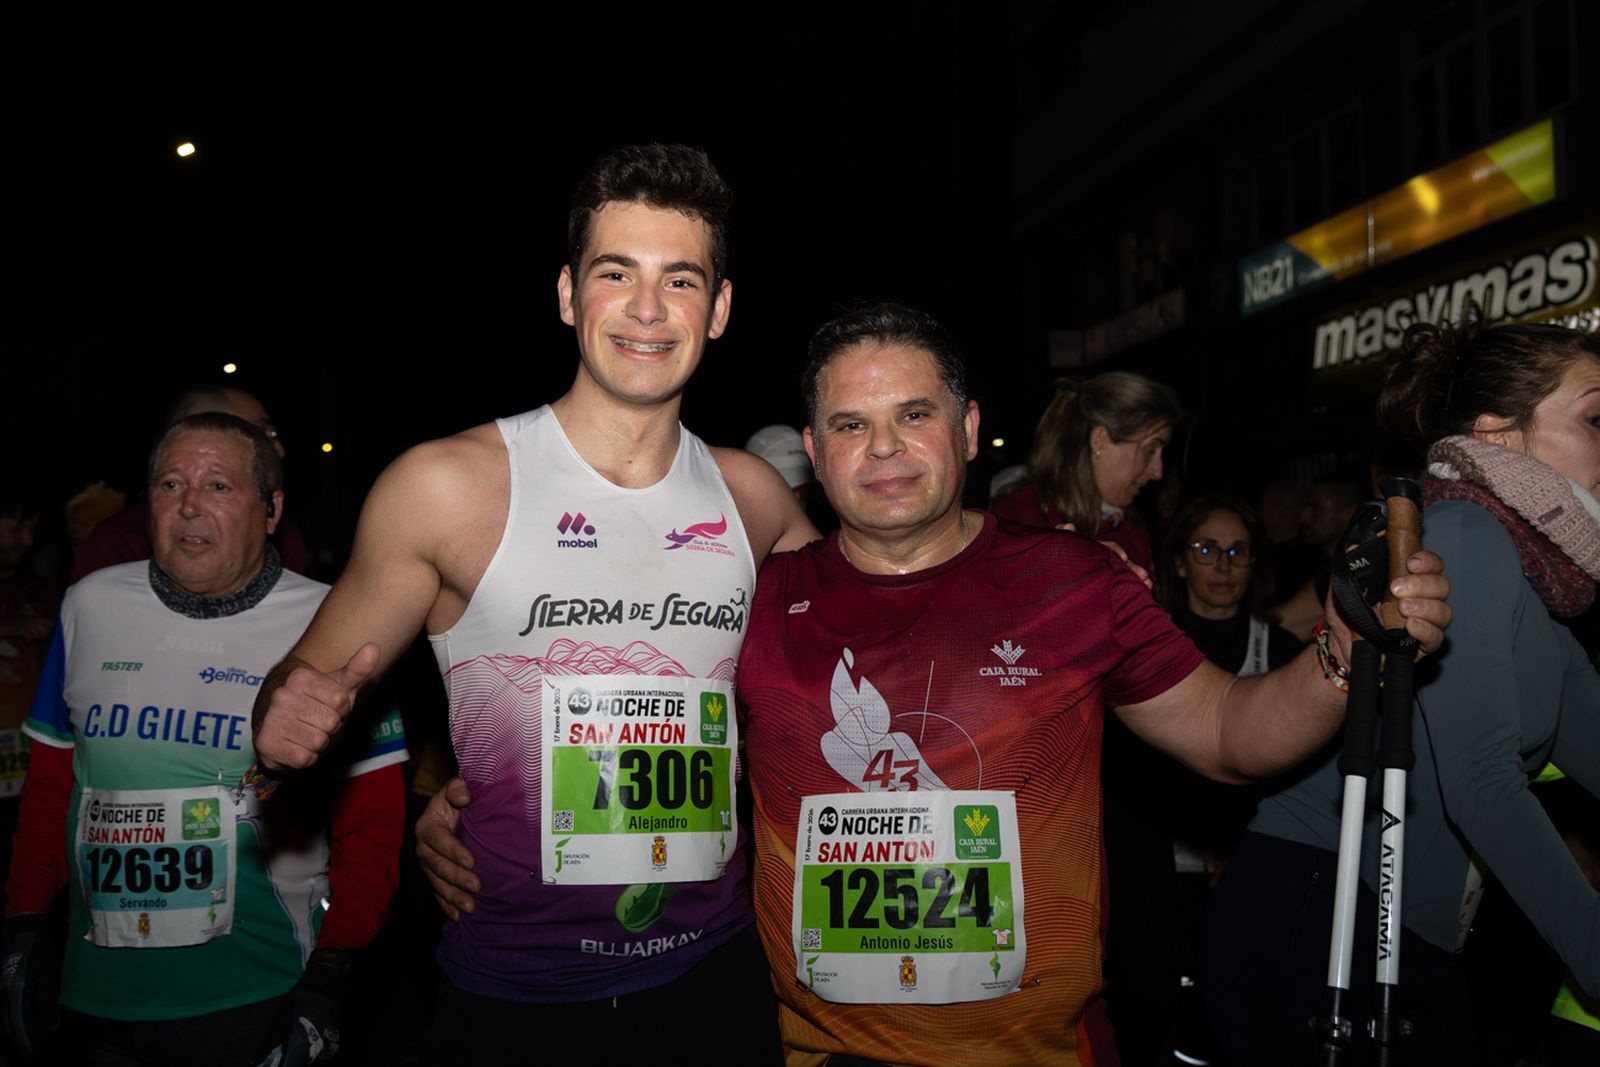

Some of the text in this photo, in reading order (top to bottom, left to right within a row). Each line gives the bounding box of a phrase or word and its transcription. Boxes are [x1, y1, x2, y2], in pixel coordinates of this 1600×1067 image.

[1244, 256, 1293, 306] NB21
[1312, 239, 1588, 370] masymas
[558, 538, 598, 548] mobel
[519, 593, 744, 637] SIERRA DE SEGURA
[101, 661, 143, 671] FASTER
[979, 667, 1042, 676] CAJA RURAL
[1000, 676, 1026, 686] JAÉN
[569, 693, 591, 709] 43
[623, 689, 645, 697] URBANA
[646, 689, 685, 698] INTERNACIONAL
[553, 706, 560, 715] de
[596, 698, 685, 717] NOCHE DE
[84, 704, 246, 751] C.D GILETE
[569, 718, 686, 745] SAN ANTÓN
[588, 749, 713, 811] 7306
[863, 749, 919, 792] 43
[102, 808, 165, 823] NOCHE DE
[819, 812, 837, 827] 43
[841, 808, 866, 816] CARRERA
[866, 807, 888, 815] URBANA
[629, 815, 688, 832] Alejandro
[841, 815, 933, 835] NOCHE DE
[88, 827, 109, 843] SAN
[111, 823, 165, 844] ANTÓN
[818, 841, 857, 863] SAN
[86, 845, 213, 894] 12639
[120, 897, 167, 908] Servando
[820, 867, 994, 930] 12524
[1378, 843, 1395, 961] ATACAMA
[860, 935, 953, 949] Antonio Jesús
